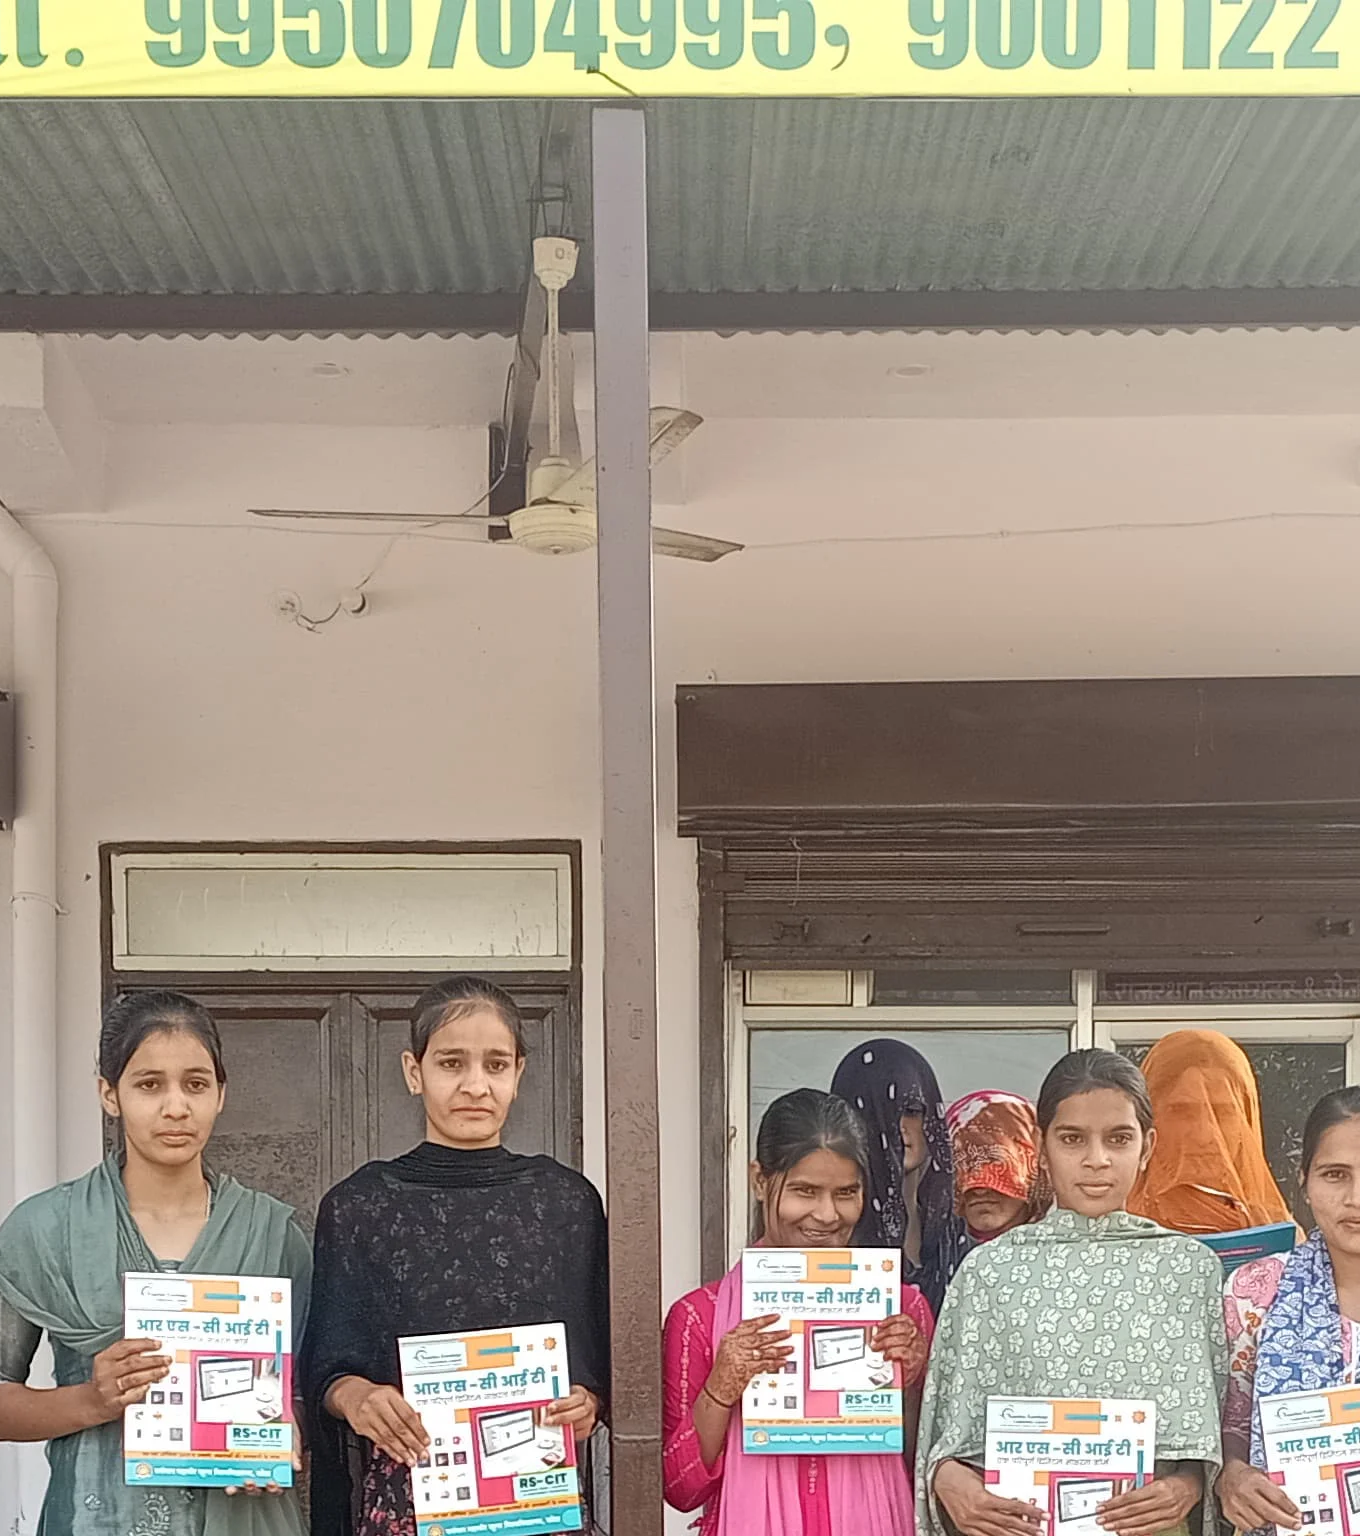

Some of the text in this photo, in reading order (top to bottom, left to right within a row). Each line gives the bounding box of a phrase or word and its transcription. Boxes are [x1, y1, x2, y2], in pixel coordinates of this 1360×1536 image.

[753, 1292, 777, 1304] आर
[782, 1292, 803, 1304] एस
[816, 1288, 833, 1304] सी
[840, 1288, 865, 1305] आई
[866, 1288, 880, 1304] टी
[137, 1319, 162, 1332] आर
[167, 1320, 189, 1332] एस
[203, 1317, 220, 1334] सी
[225, 1320, 253, 1335] आई
[255, 1319, 269, 1335] टी
[414, 1382, 439, 1396] आर
[444, 1379, 466, 1394] एस
[479, 1373, 498, 1390] सी
[502, 1369, 530, 1387] आई
[531, 1367, 545, 1384] टी
[845, 1394, 893, 1404] RS-CIT
[233, 1428, 282, 1438] RS-CIT
[997, 1441, 1022, 1454] आर
[1027, 1442, 1049, 1454] एस
[1063, 1439, 1080, 1455] सी
[1085, 1440, 1115, 1457] आई
[1116, 1439, 1131, 1456] टी
[1277, 1438, 1303, 1453] आर
[1307, 1435, 1330, 1449] एस
[520, 1473, 567, 1488] RS-CIT
